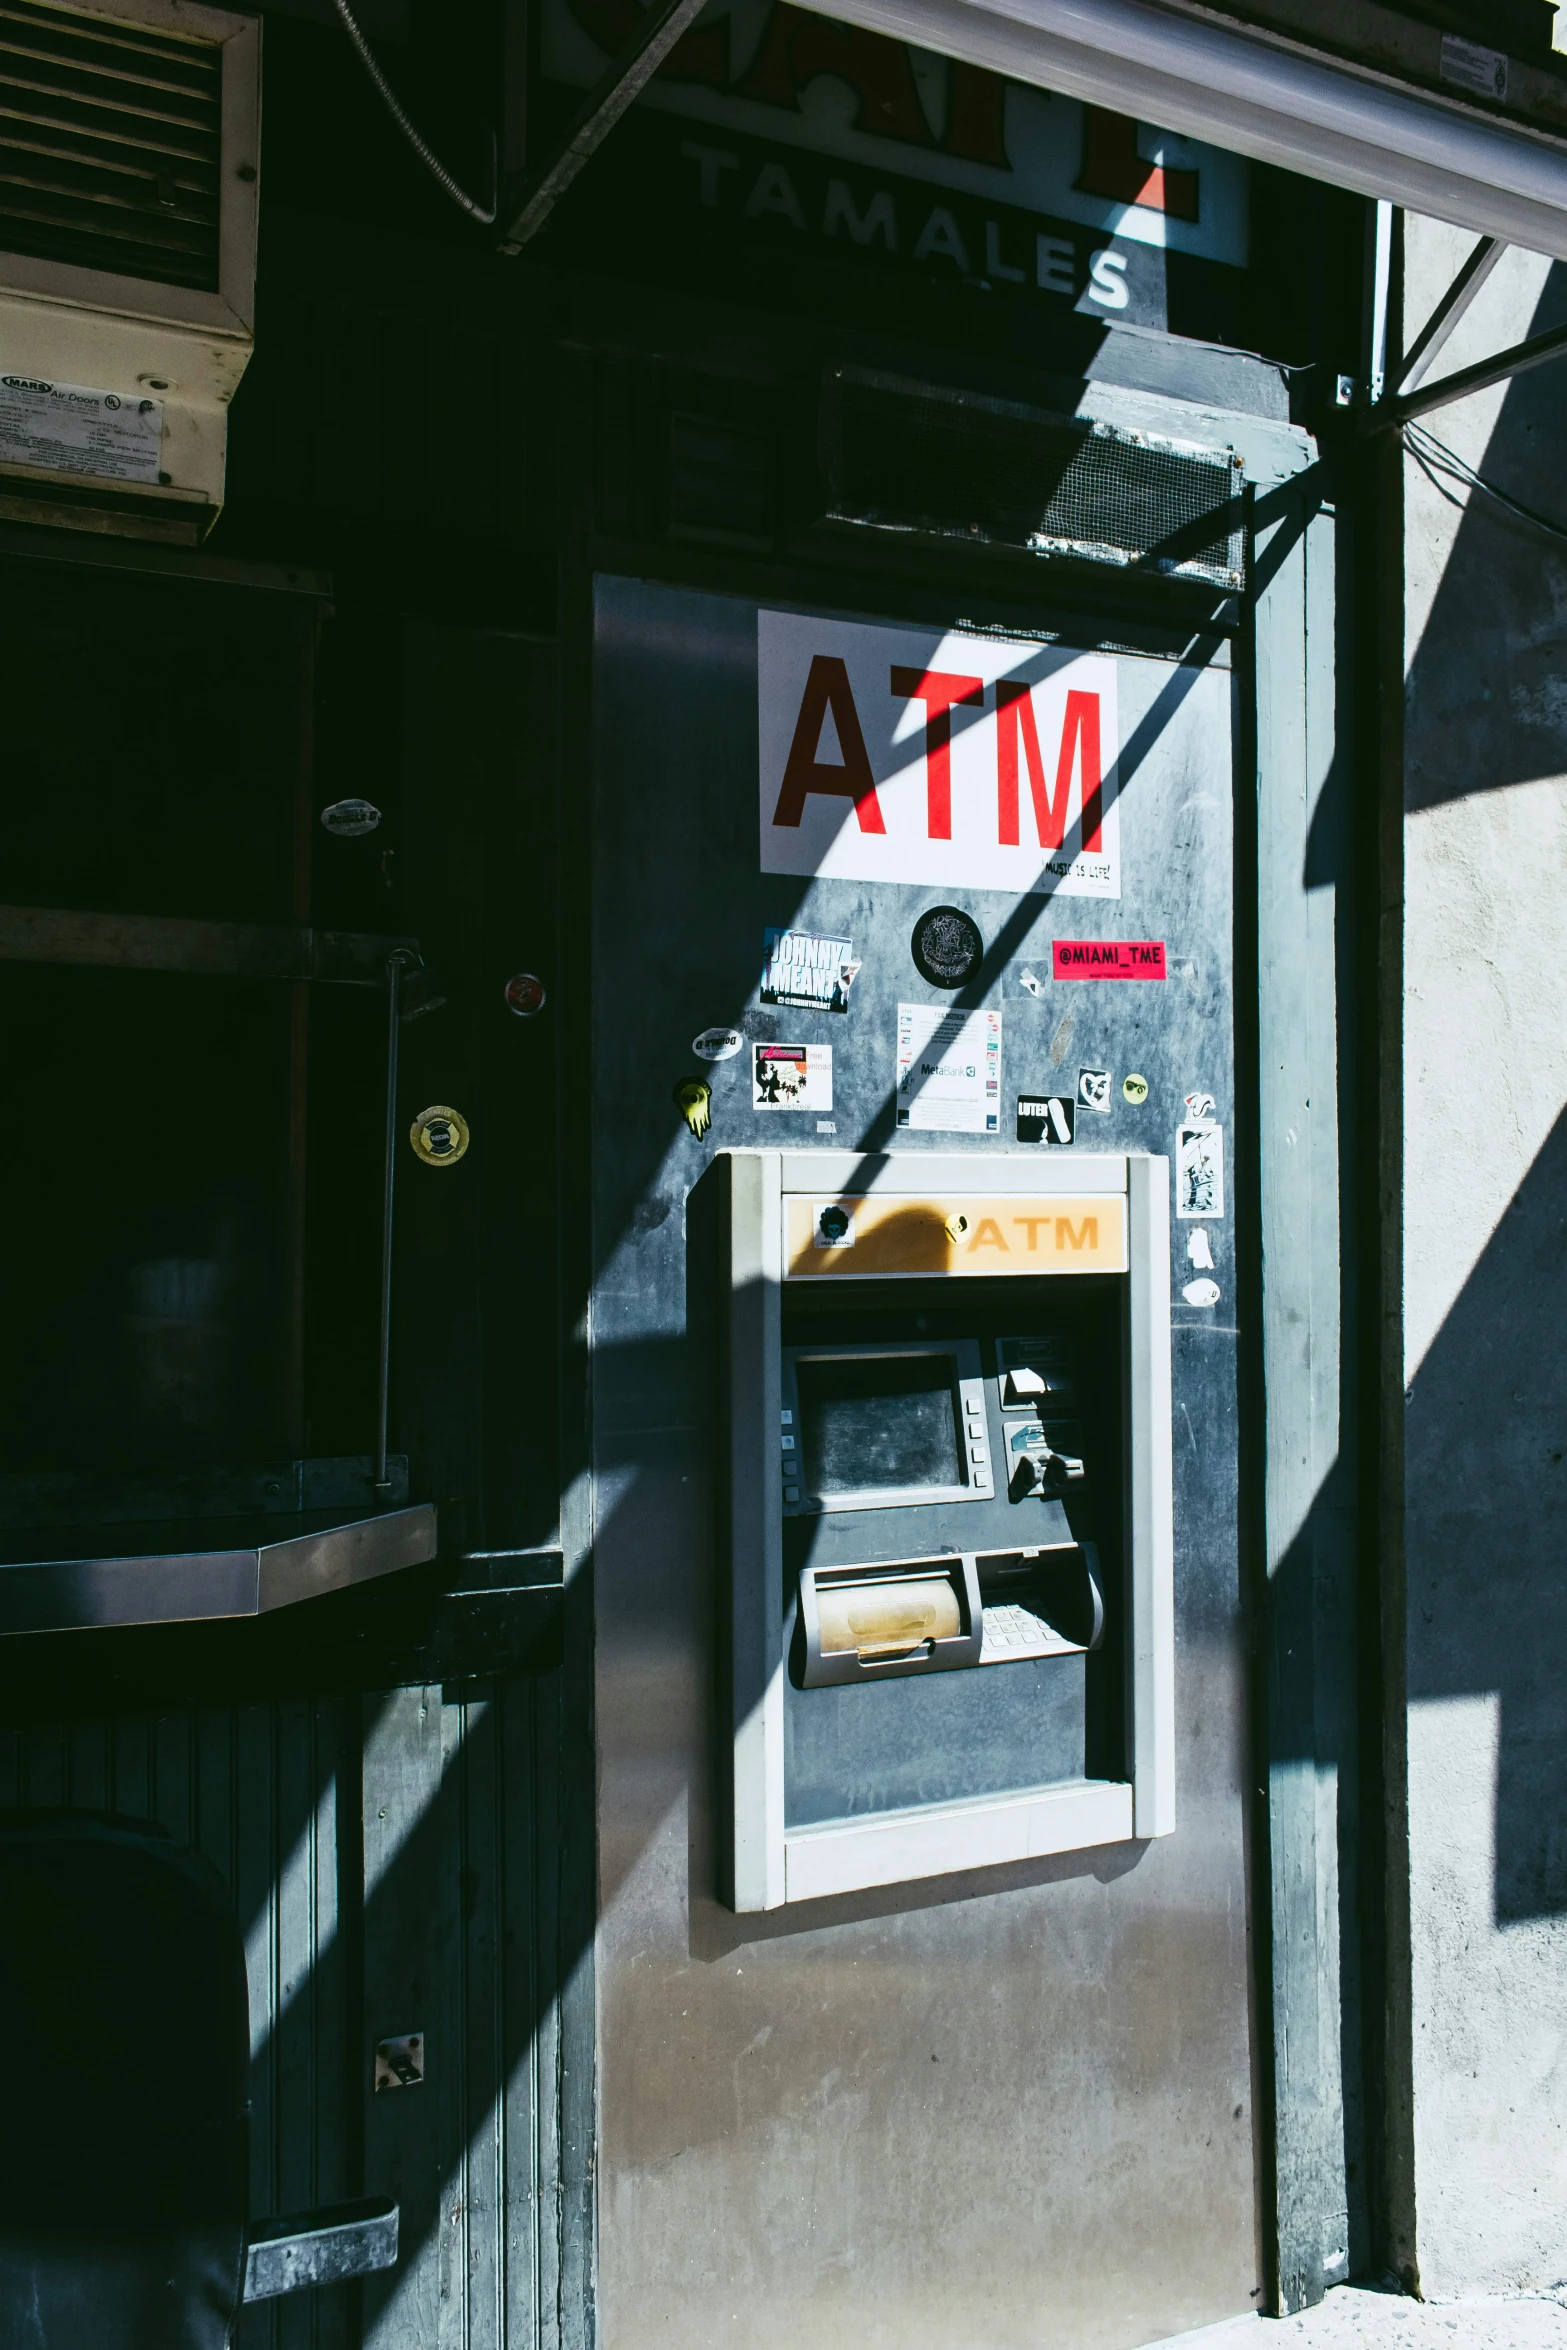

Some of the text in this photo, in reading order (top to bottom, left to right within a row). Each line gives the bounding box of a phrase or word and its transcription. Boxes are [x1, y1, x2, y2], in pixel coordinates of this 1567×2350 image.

[681, 141, 1130, 310] TAMALES
[9, 378, 46, 392] MARS
[51, 390, 100, 406] Air Doors
[772, 654, 1103, 853] ATM
[1045, 862, 1111, 880] MUSIC IS LIFE!
[771, 934, 844, 970] JOHNNY
[1059, 947, 1162, 968] @MIAMI_TME
[773, 964, 839, 998] MEANT
[695, 1036, 737, 1050] DOUBLE D
[796, 1062, 832, 1070] download
[921, 1064, 966, 1077] MetaBank
[1018, 1102, 1049, 1117] LUTER
[966, 1217, 1099, 1252] ATM
